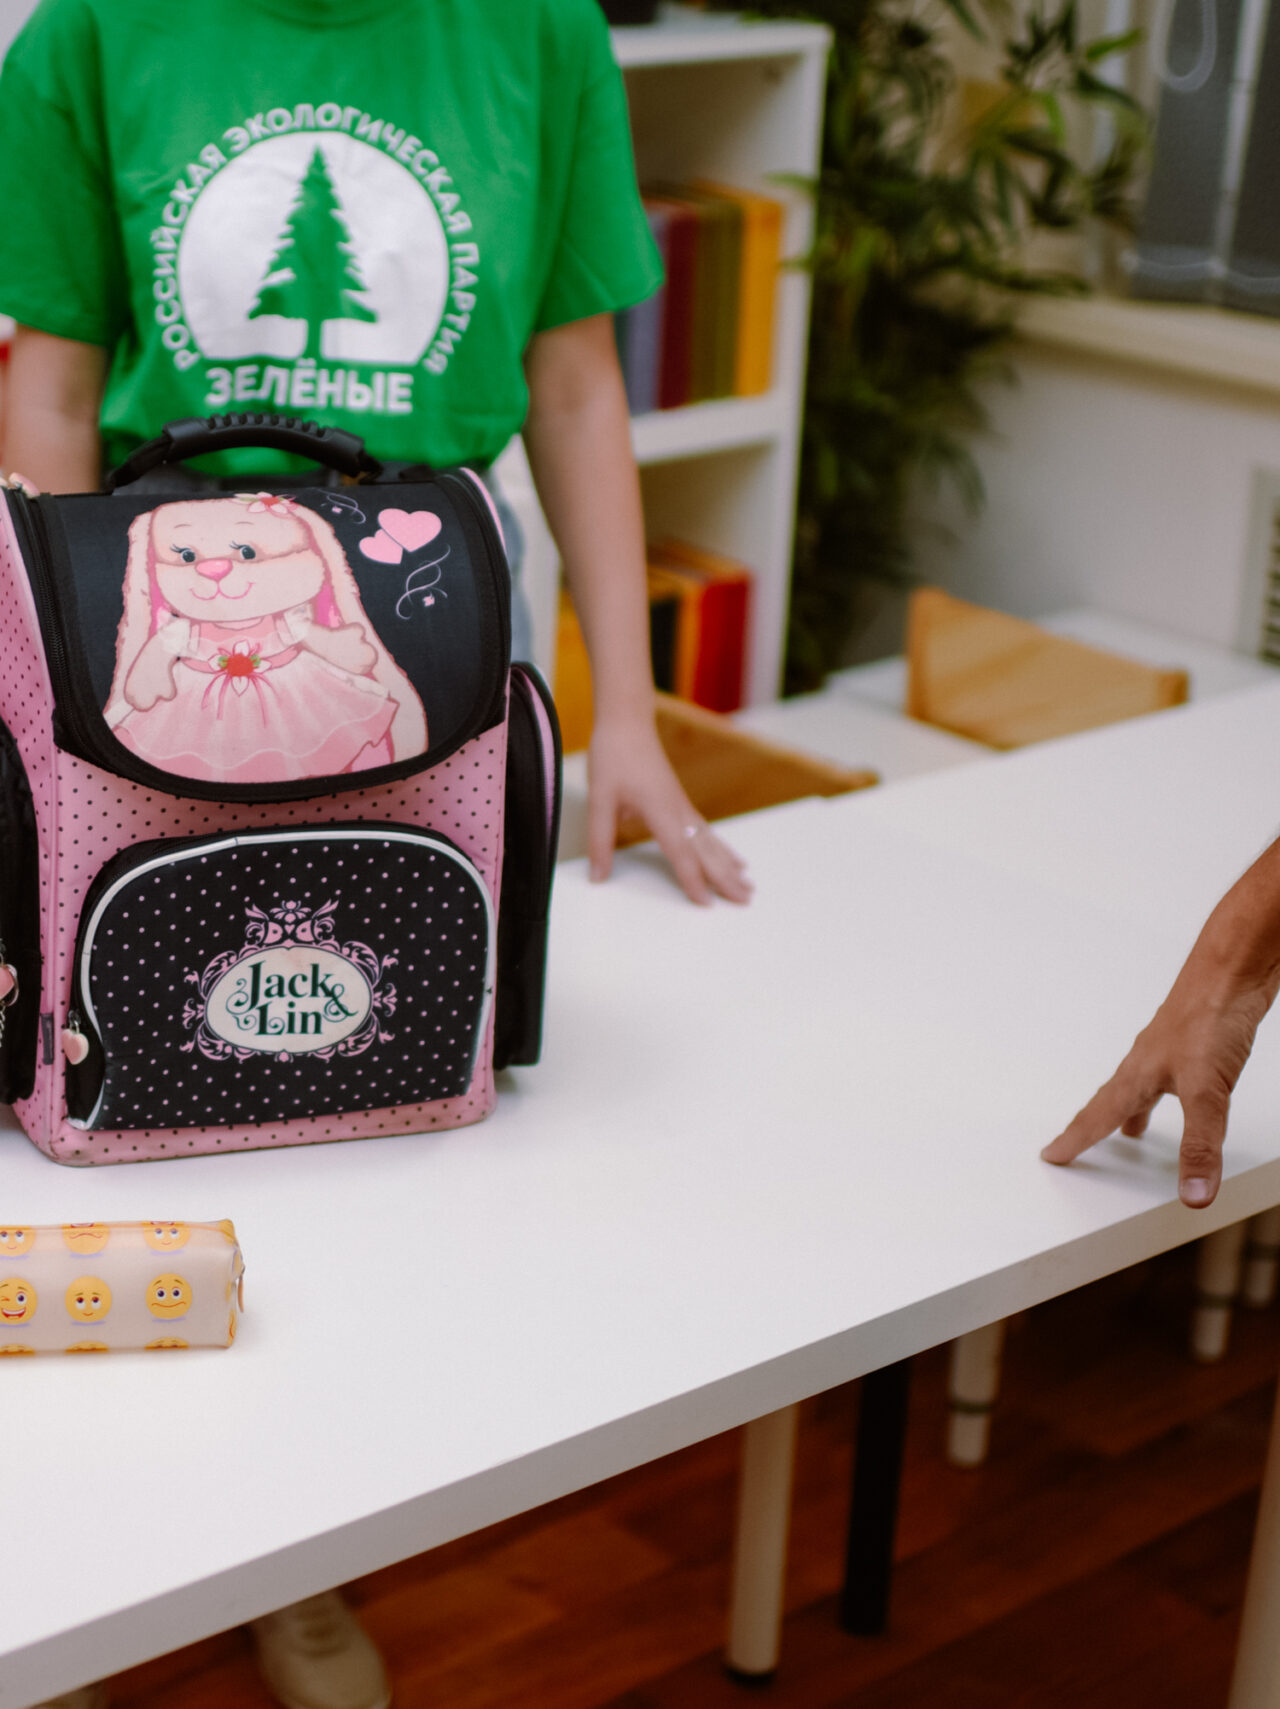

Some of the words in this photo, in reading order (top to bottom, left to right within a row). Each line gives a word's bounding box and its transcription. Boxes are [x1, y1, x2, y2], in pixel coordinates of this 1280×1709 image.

[150, 142, 227, 371] РОССИЙСКАЯ
[222, 102, 473, 236] ЭКОЛОГИЧЕСКАЯ
[423, 242, 480, 376] ПАРТИЯ
[205, 357, 414, 414] ЗЕЛЁНЫЕ
[226, 960, 334, 1015] Jack
[324, 984, 359, 1023] &
[233, 1001, 324, 1036] Lin
